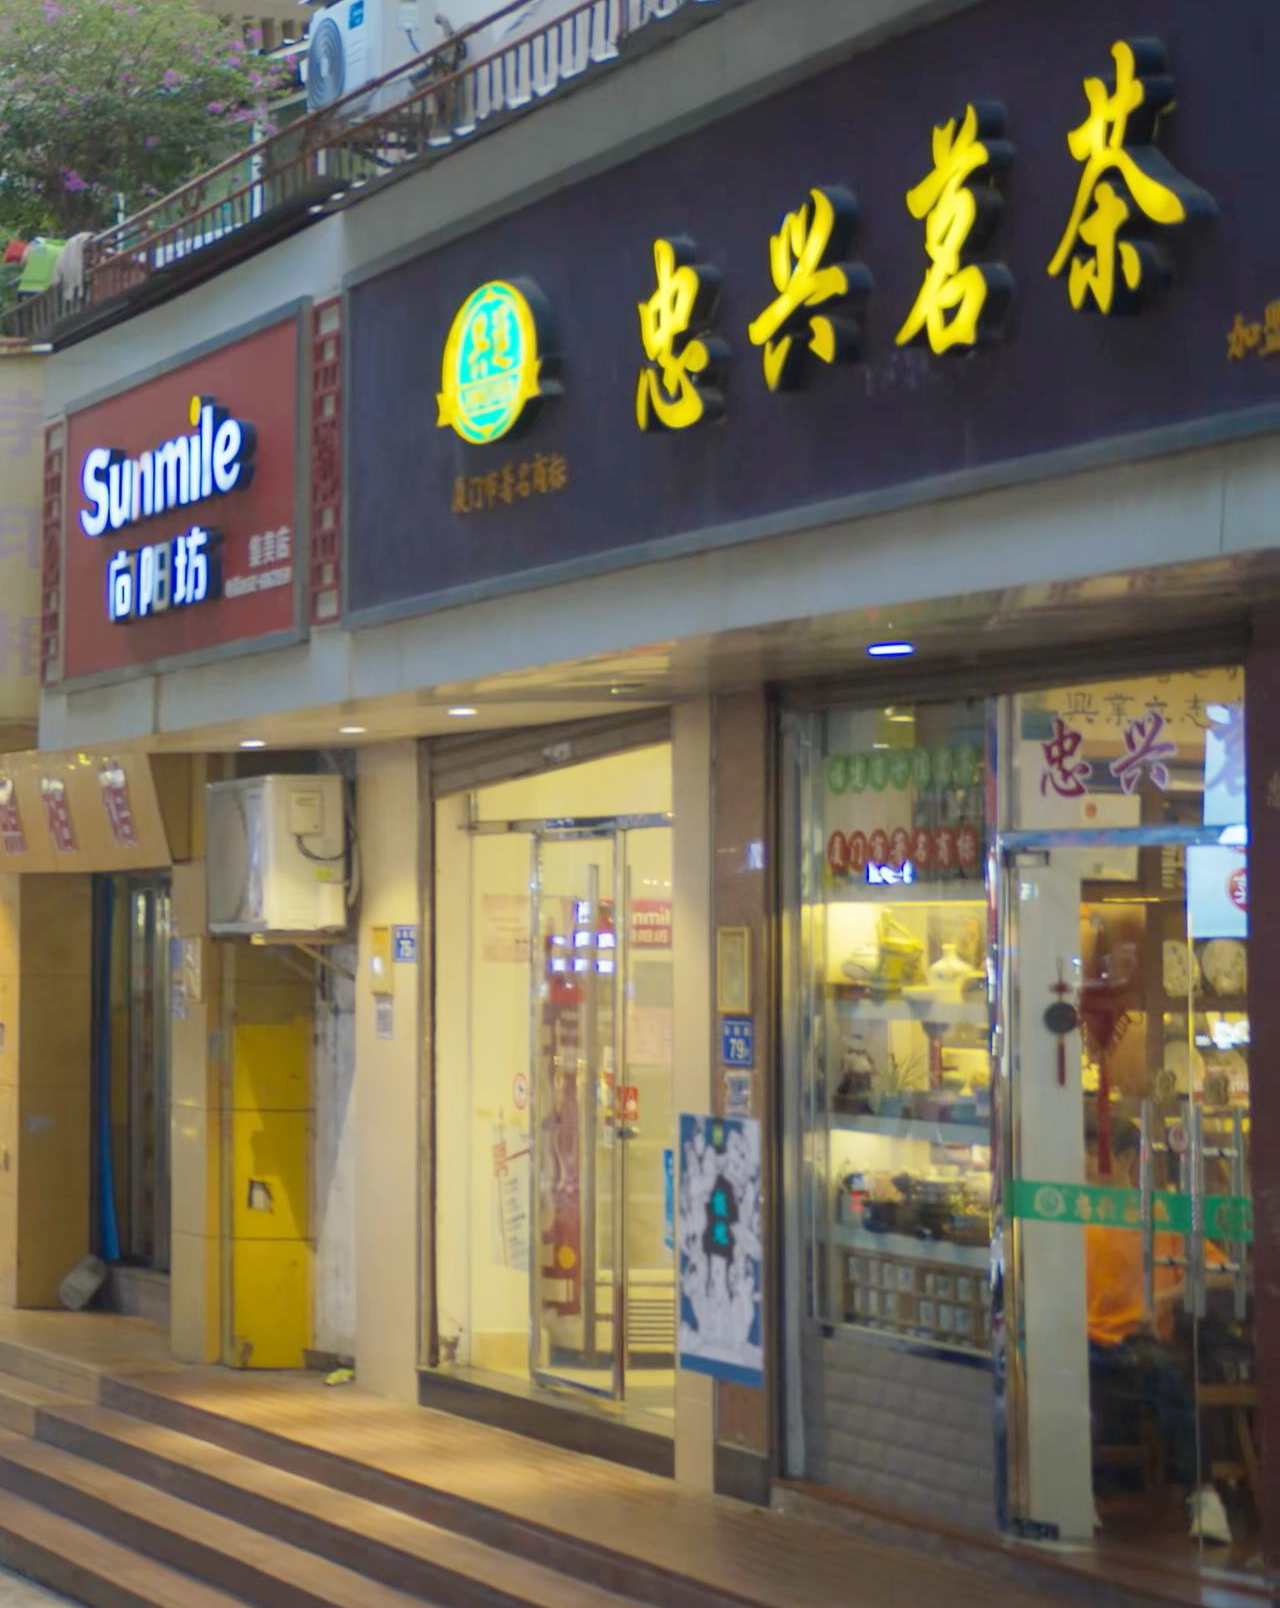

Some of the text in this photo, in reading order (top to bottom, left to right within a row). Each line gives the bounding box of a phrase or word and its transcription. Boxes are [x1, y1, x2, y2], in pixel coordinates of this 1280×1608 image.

[635, 38, 1186, 431] 忠兴茗茶
[108, 526, 207, 622] 向阳坊
